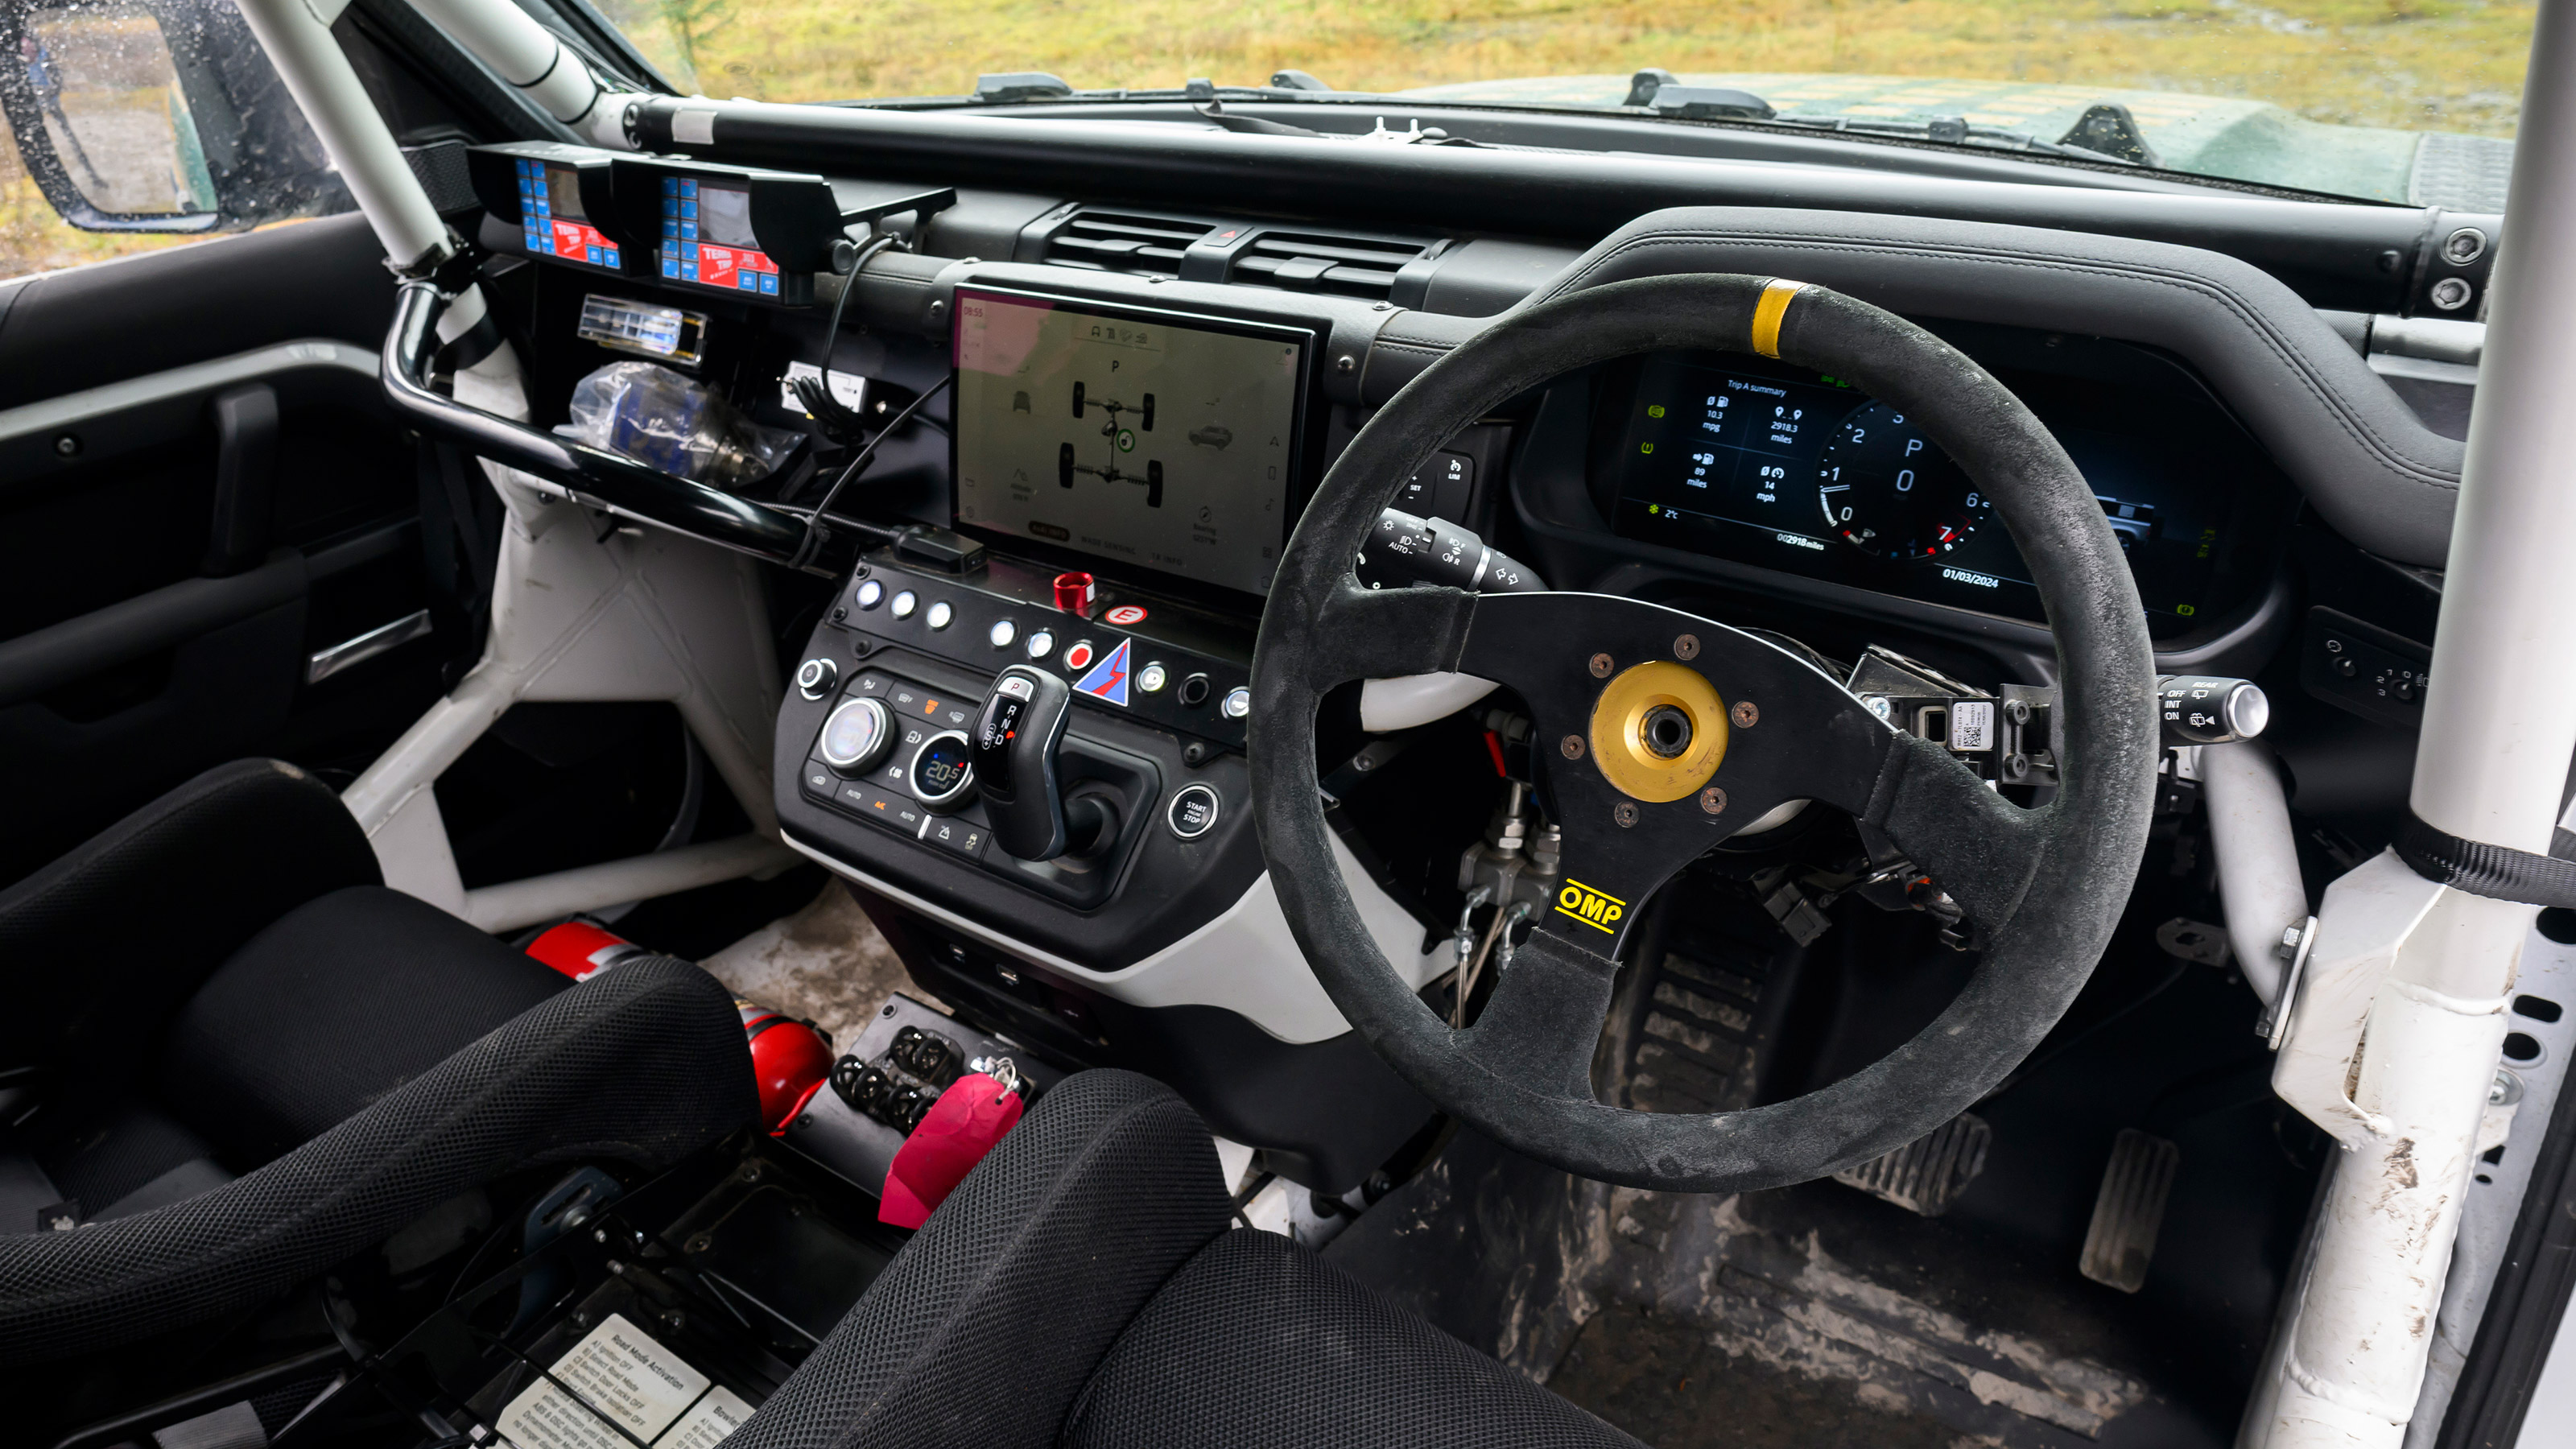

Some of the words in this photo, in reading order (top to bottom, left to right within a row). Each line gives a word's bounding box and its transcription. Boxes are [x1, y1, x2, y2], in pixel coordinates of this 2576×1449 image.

[1111, 359, 1121, 373] P
[1728, 379, 1742, 391] Trip
[1742, 382, 1749, 390] A
[1750, 384, 1787, 398] summary
[1707, 410, 1724, 419] 10.3
[1702, 422, 1721, 433] mpg
[1770, 421, 1798, 433] 2918.3
[1770, 435, 1793, 444] miles
[1852, 428, 1865, 444] 2
[1905, 439, 1923, 457] P
[1448, 473, 1461, 481] LIM
[1694, 467, 1706, 477] 89
[1831, 467, 1840, 481] 1
[1686, 478, 1707, 489] miles
[1765, 481, 1775, 490] 14
[1897, 469, 1915, 492] 0
[1410, 484, 1422, 492] SET
[1756, 493, 1776, 503] mph
[1966, 492, 1979, 508] 6
[1840, 506, 1853, 522] 0
[1938, 526, 1952, 541] 7
[1388, 541, 1409, 554] AUTO
[1453, 557, 1461, 566] R
[1942, 568, 2000, 588] 01/03/2024
[1113, 609, 1139, 621] E
[2376, 675, 2385, 684] 2
[1010, 683, 1020, 691] P
[2166, 690, 2187, 698] OFF
[1006, 704, 1018, 716] R
[2164, 700, 2182, 709] INT
[2164, 712, 2180, 720] ON
[1001, 718, 1011, 730] N
[994, 733, 1005, 746] D
[1005, 730, 1015, 740] P
[926, 760, 960, 782] 20.5
[846, 789, 862, 800] AUTO
[1186, 801, 1208, 813] START
[899, 811, 916, 823] AUTO
[1183, 814, 1201, 824] STOP
[1559, 886, 1622, 925] OMP
[598, 1345, 621, 1363] Ignition
[619, 1360, 633, 1371] OFF
[611, 1335, 630, 1350] Road
[628, 1348, 650, 1364] Mode
[647, 1361, 685, 1389] Activation
[589, 1353, 609, 1368] Select
[606, 1366, 623, 1379] Road
[621, 1377, 639, 1391] Mode
[580, 1361, 601, 1377] Switch
[598, 1376, 614, 1388] Door
[612, 1386, 631, 1401] Locks
[630, 1398, 643, 1410] OFF
[570, 1369, 591, 1385] Switch
[589, 1384, 608, 1398] Brake
[605, 1397, 633, 1418] Isolation
[630, 1415, 645, 1427] OFF
[541, 1394, 560, 1410] either
[557, 1407, 586, 1429] direction
[582, 1426, 599, 1439] until
[596, 1436, 613, 1449] DSC
[712, 1406, 741, 1427] Bowler
[512, 1419, 522, 1428] no
[518, 1425, 542, 1443] longer
[521, 1410, 564, 1443] Dynamometer
[532, 1402, 547, 1414] ABS
[549, 1416, 564, 1428] DSC
[559, 1425, 580, 1442] lights
[576, 1439, 588, 1448] go
[698, 1430, 717, 1445] Select
